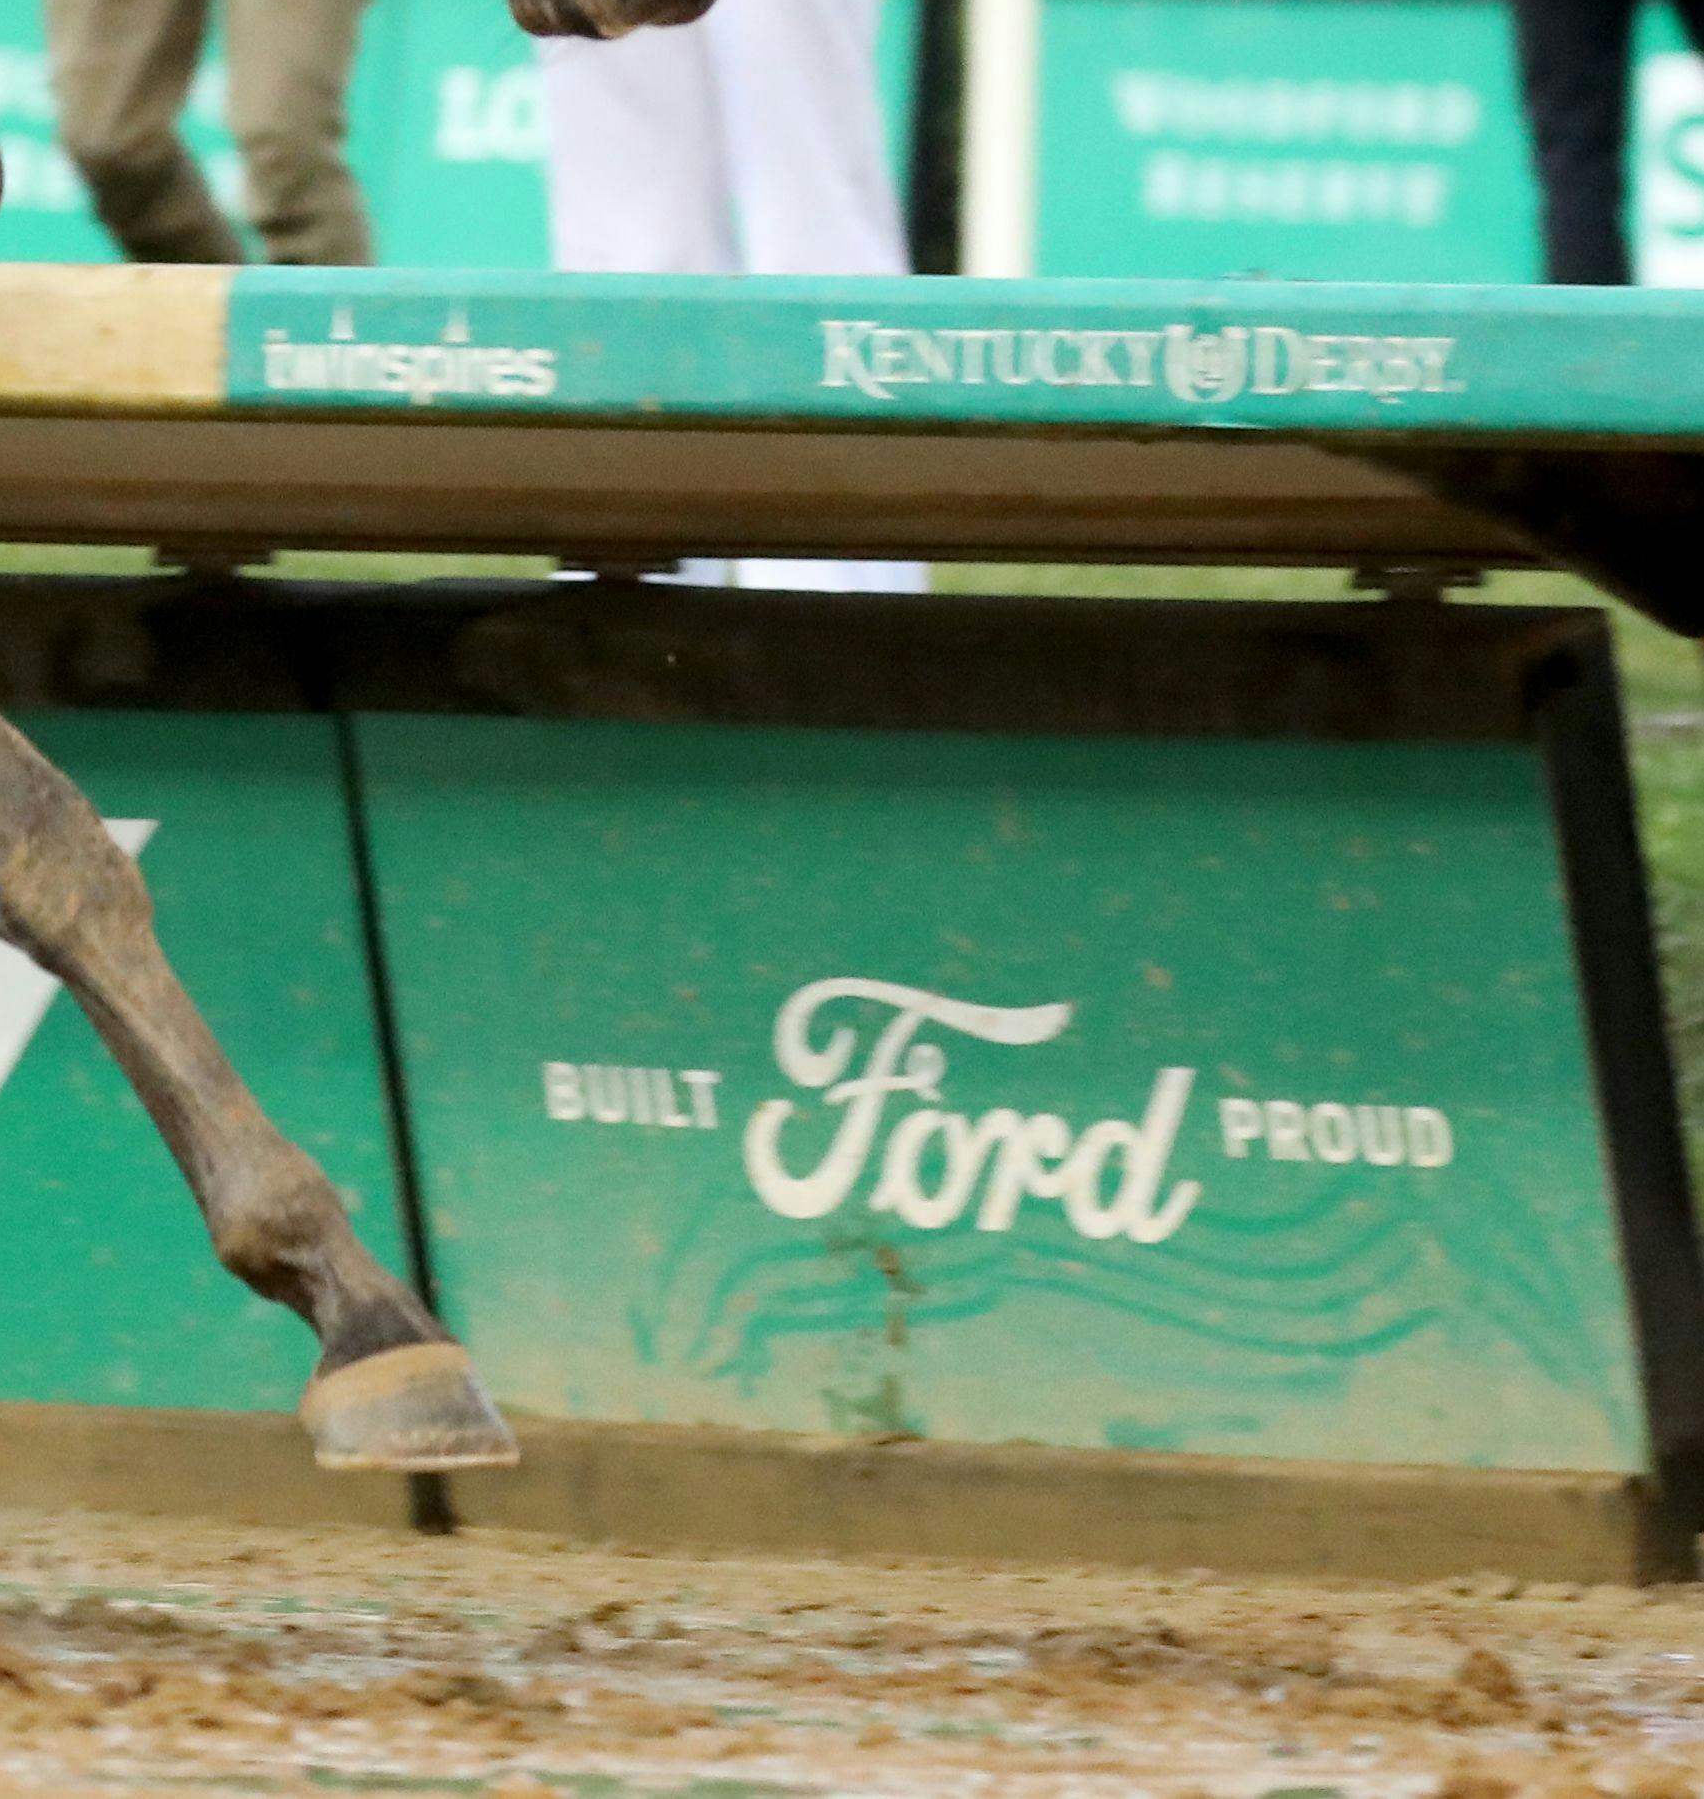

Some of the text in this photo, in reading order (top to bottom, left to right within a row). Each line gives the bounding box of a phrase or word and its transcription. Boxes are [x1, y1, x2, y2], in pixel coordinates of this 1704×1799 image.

[543, 976, 1455, 1244] BUILT Ford PROUD
